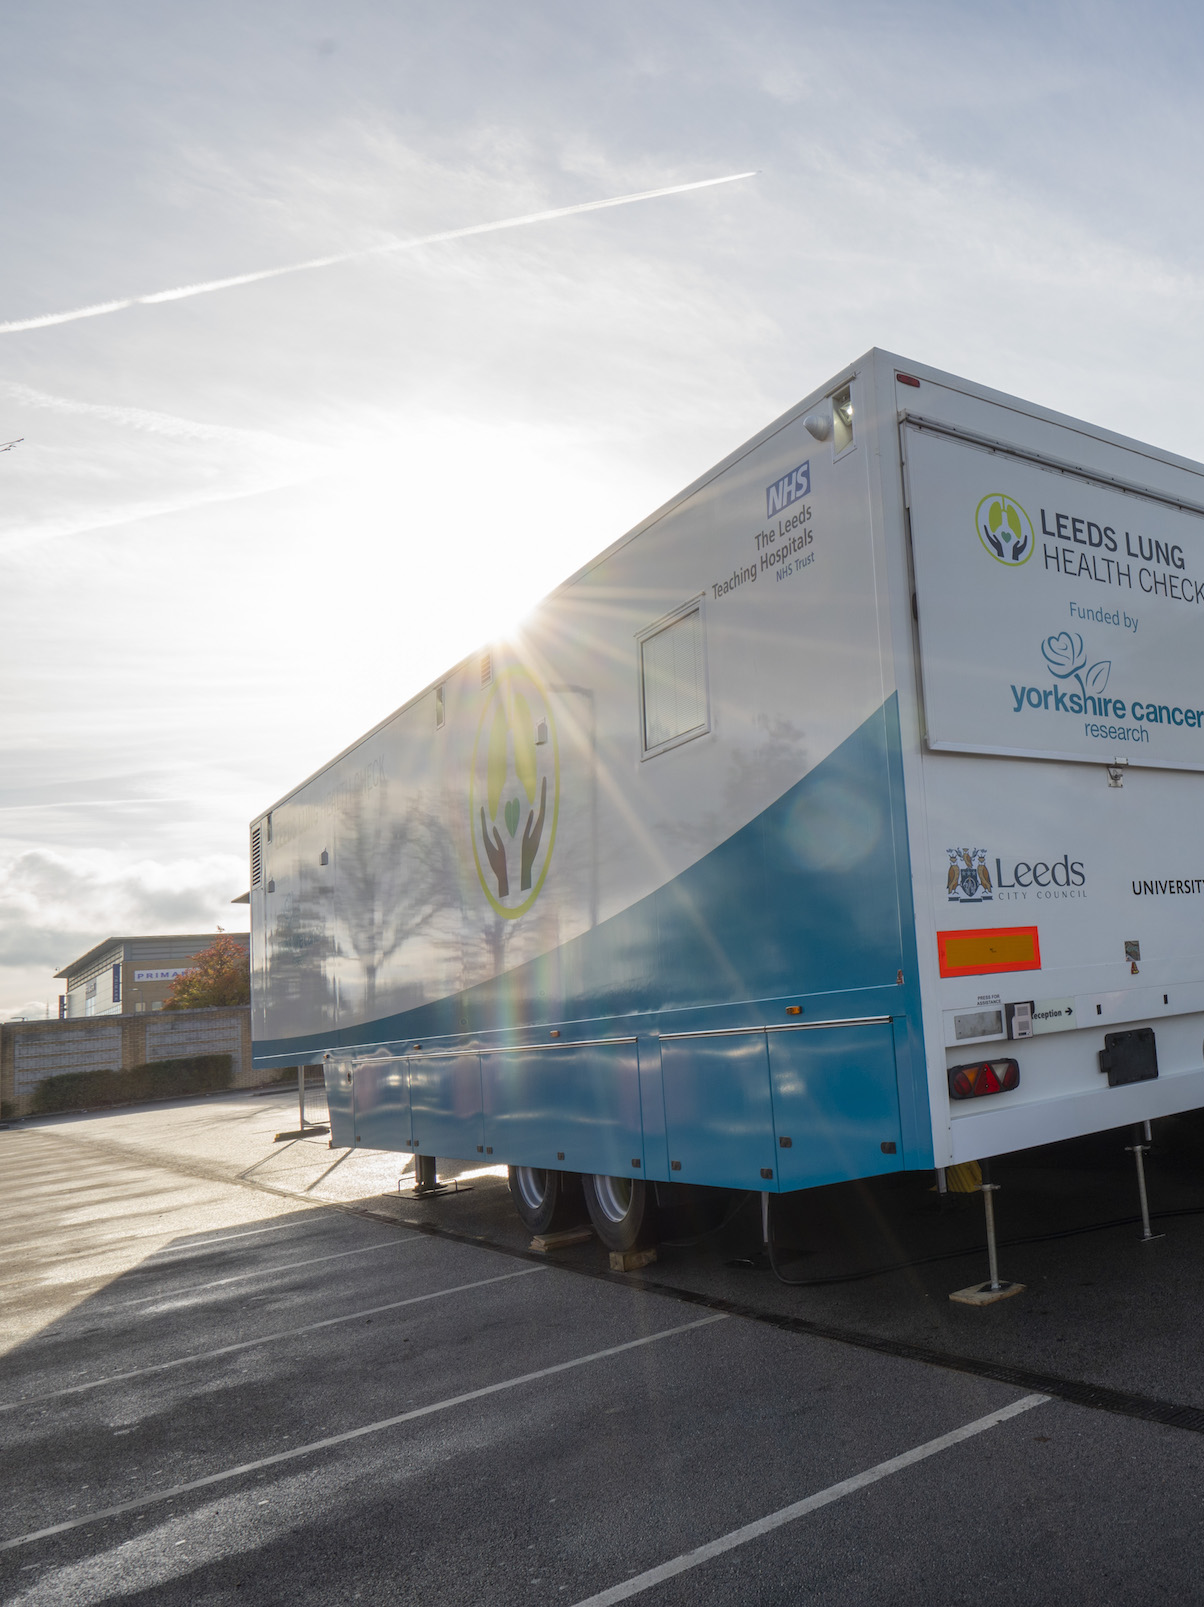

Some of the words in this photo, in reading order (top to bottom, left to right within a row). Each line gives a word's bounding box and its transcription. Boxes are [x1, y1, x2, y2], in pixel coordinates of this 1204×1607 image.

[767, 462, 809, 517] NHS
[755, 529, 775, 551] The
[779, 504, 812, 536] Leeds
[1040, 508, 1118, 552] LEEDS
[1125, 531, 1186, 570] LUNG
[712, 563, 757, 600] Teaching
[760, 528, 814, 572] Hospitals
[776, 563, 793, 583] NHS
[795, 552, 815, 573] Trust
[1043, 543, 1132, 589] HEALTH
[1069, 601, 1120, 626] Funded
[1123, 611, 1139, 633] by
[1010, 684, 1127, 719] yorkshire
[1131, 700, 1204, 729] cancer
[1084, 721, 1149, 743] research
[995, 854, 1086, 888] Leeds
[998, 891, 1027, 900] CITY
[1036, 890, 1087, 899] COUNCIL
[137, 970, 187, 980] PRIMA
[1032, 1009, 1062, 1020] eception
